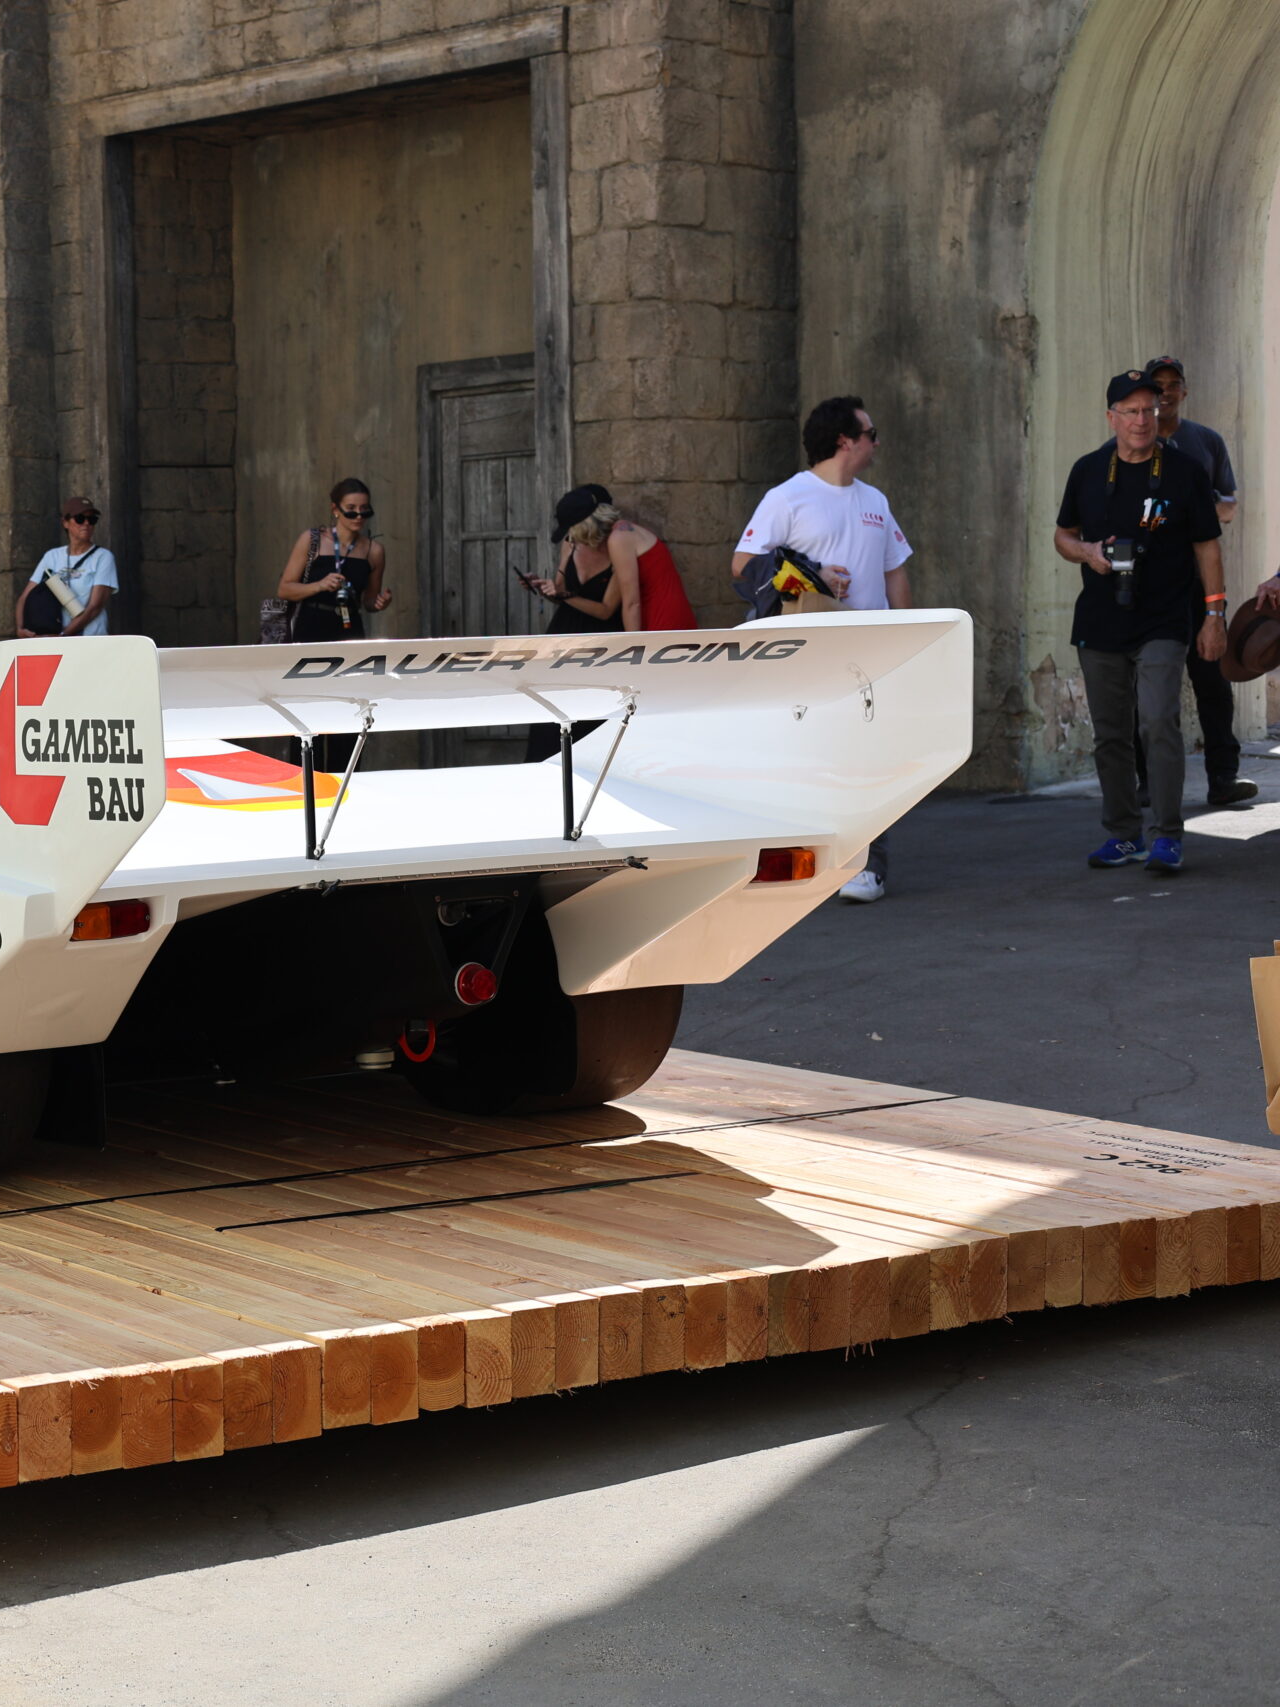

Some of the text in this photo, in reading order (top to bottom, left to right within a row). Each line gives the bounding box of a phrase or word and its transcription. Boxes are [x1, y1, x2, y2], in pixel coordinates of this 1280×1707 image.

[282, 639, 808, 680] DAUER RACING
[21, 718, 144, 765] GAMBEL
[86, 776, 145, 822] BAU
[1117, 1159, 1191, 1175] 962
